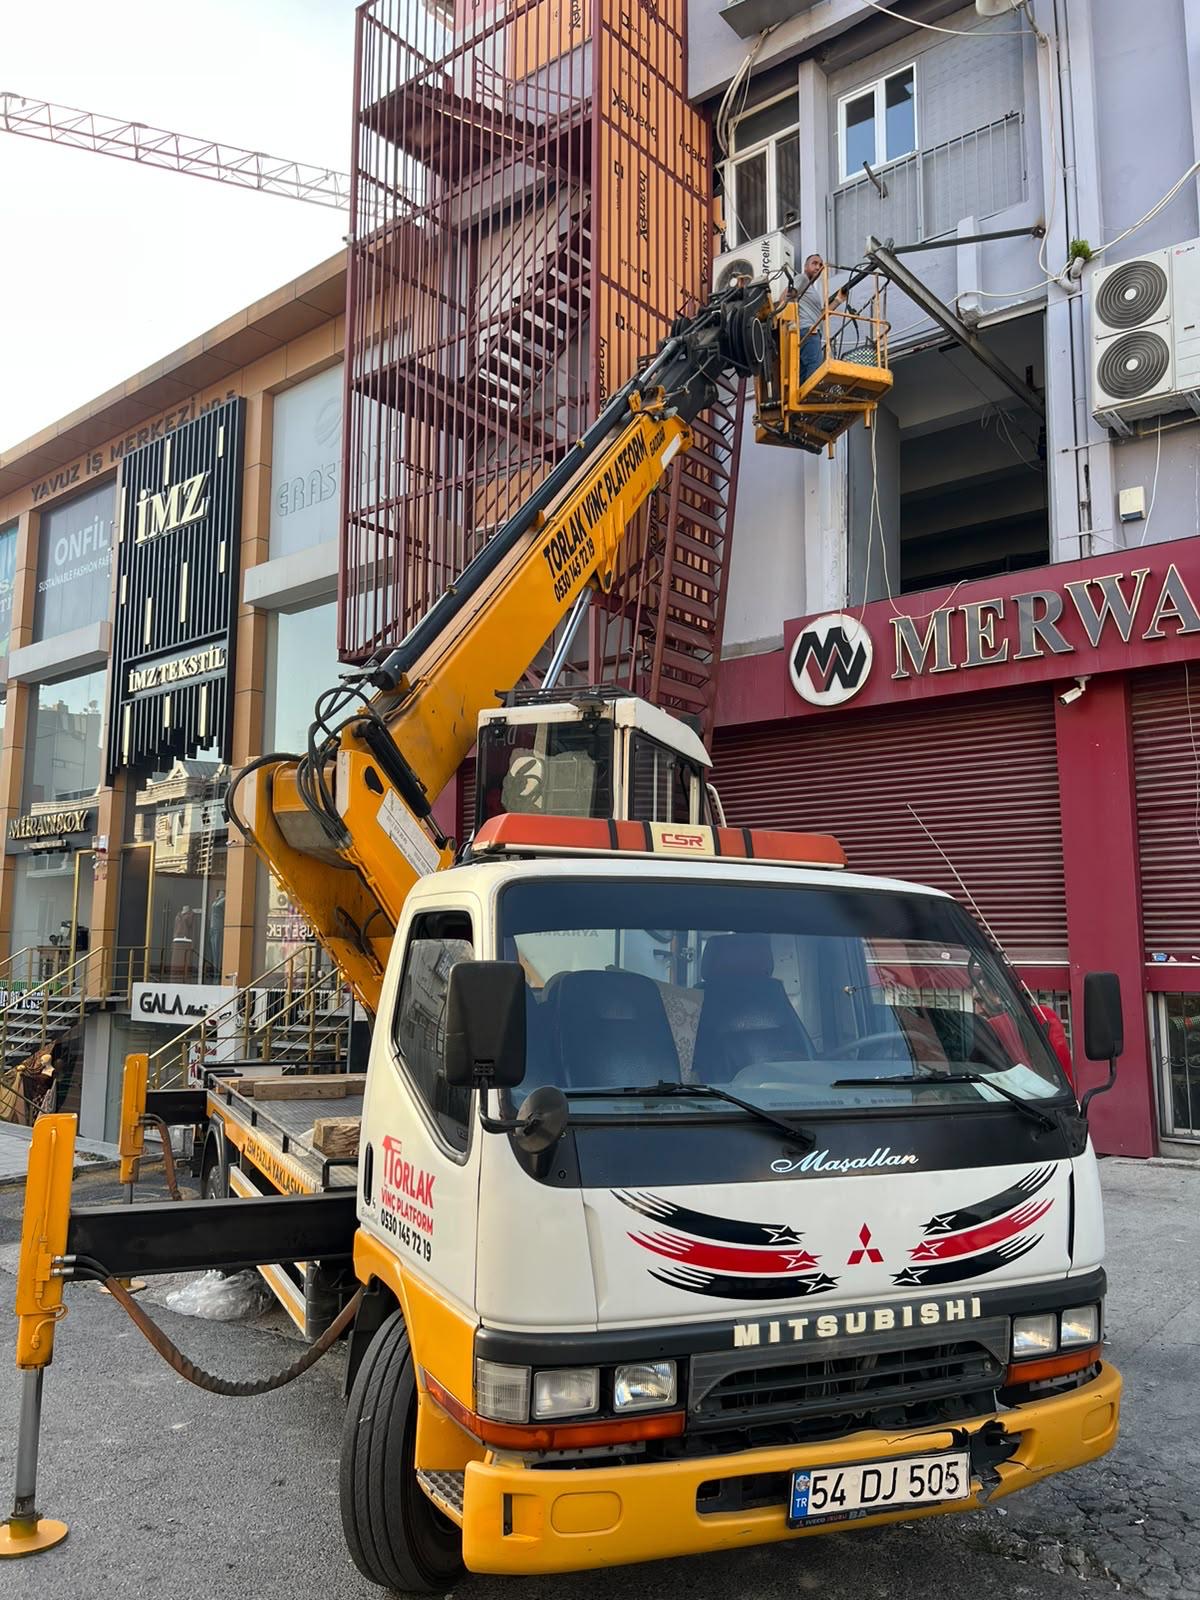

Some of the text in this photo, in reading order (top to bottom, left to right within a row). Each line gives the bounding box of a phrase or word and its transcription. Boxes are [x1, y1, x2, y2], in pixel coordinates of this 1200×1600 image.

[31, 463, 80, 502] YAVUZ
[86, 452, 103, 475] İŞ
[110, 396, 196, 462] MERKEZİ
[136, 468, 211, 545] İMZ
[543, 428, 649, 579] TORLAK VİNÇ PLATFORM
[54, 515, 108, 566] ONFİL
[554, 569, 571, 603] 0530
[568, 555, 581, 583] 145
[579, 545, 590, 568] 72
[128, 645, 226, 693] İMZ TEKSTİL
[661, 832, 703, 847] CSR
[140, 992, 184, 1016] GALA
[382, 1135, 436, 1209] TORLAK
[380, 1208, 398, 1236] 0530
[399, 1222, 411, 1247] 145
[412, 1231, 422, 1256] 72
[423, 1238, 432, 1262] 19
[396, 1197, 434, 1236] PLATFORM
[732, 1297, 982, 1347] MITSUBISHI
[795, 1460, 960, 1509] TR 54 DJ 505
